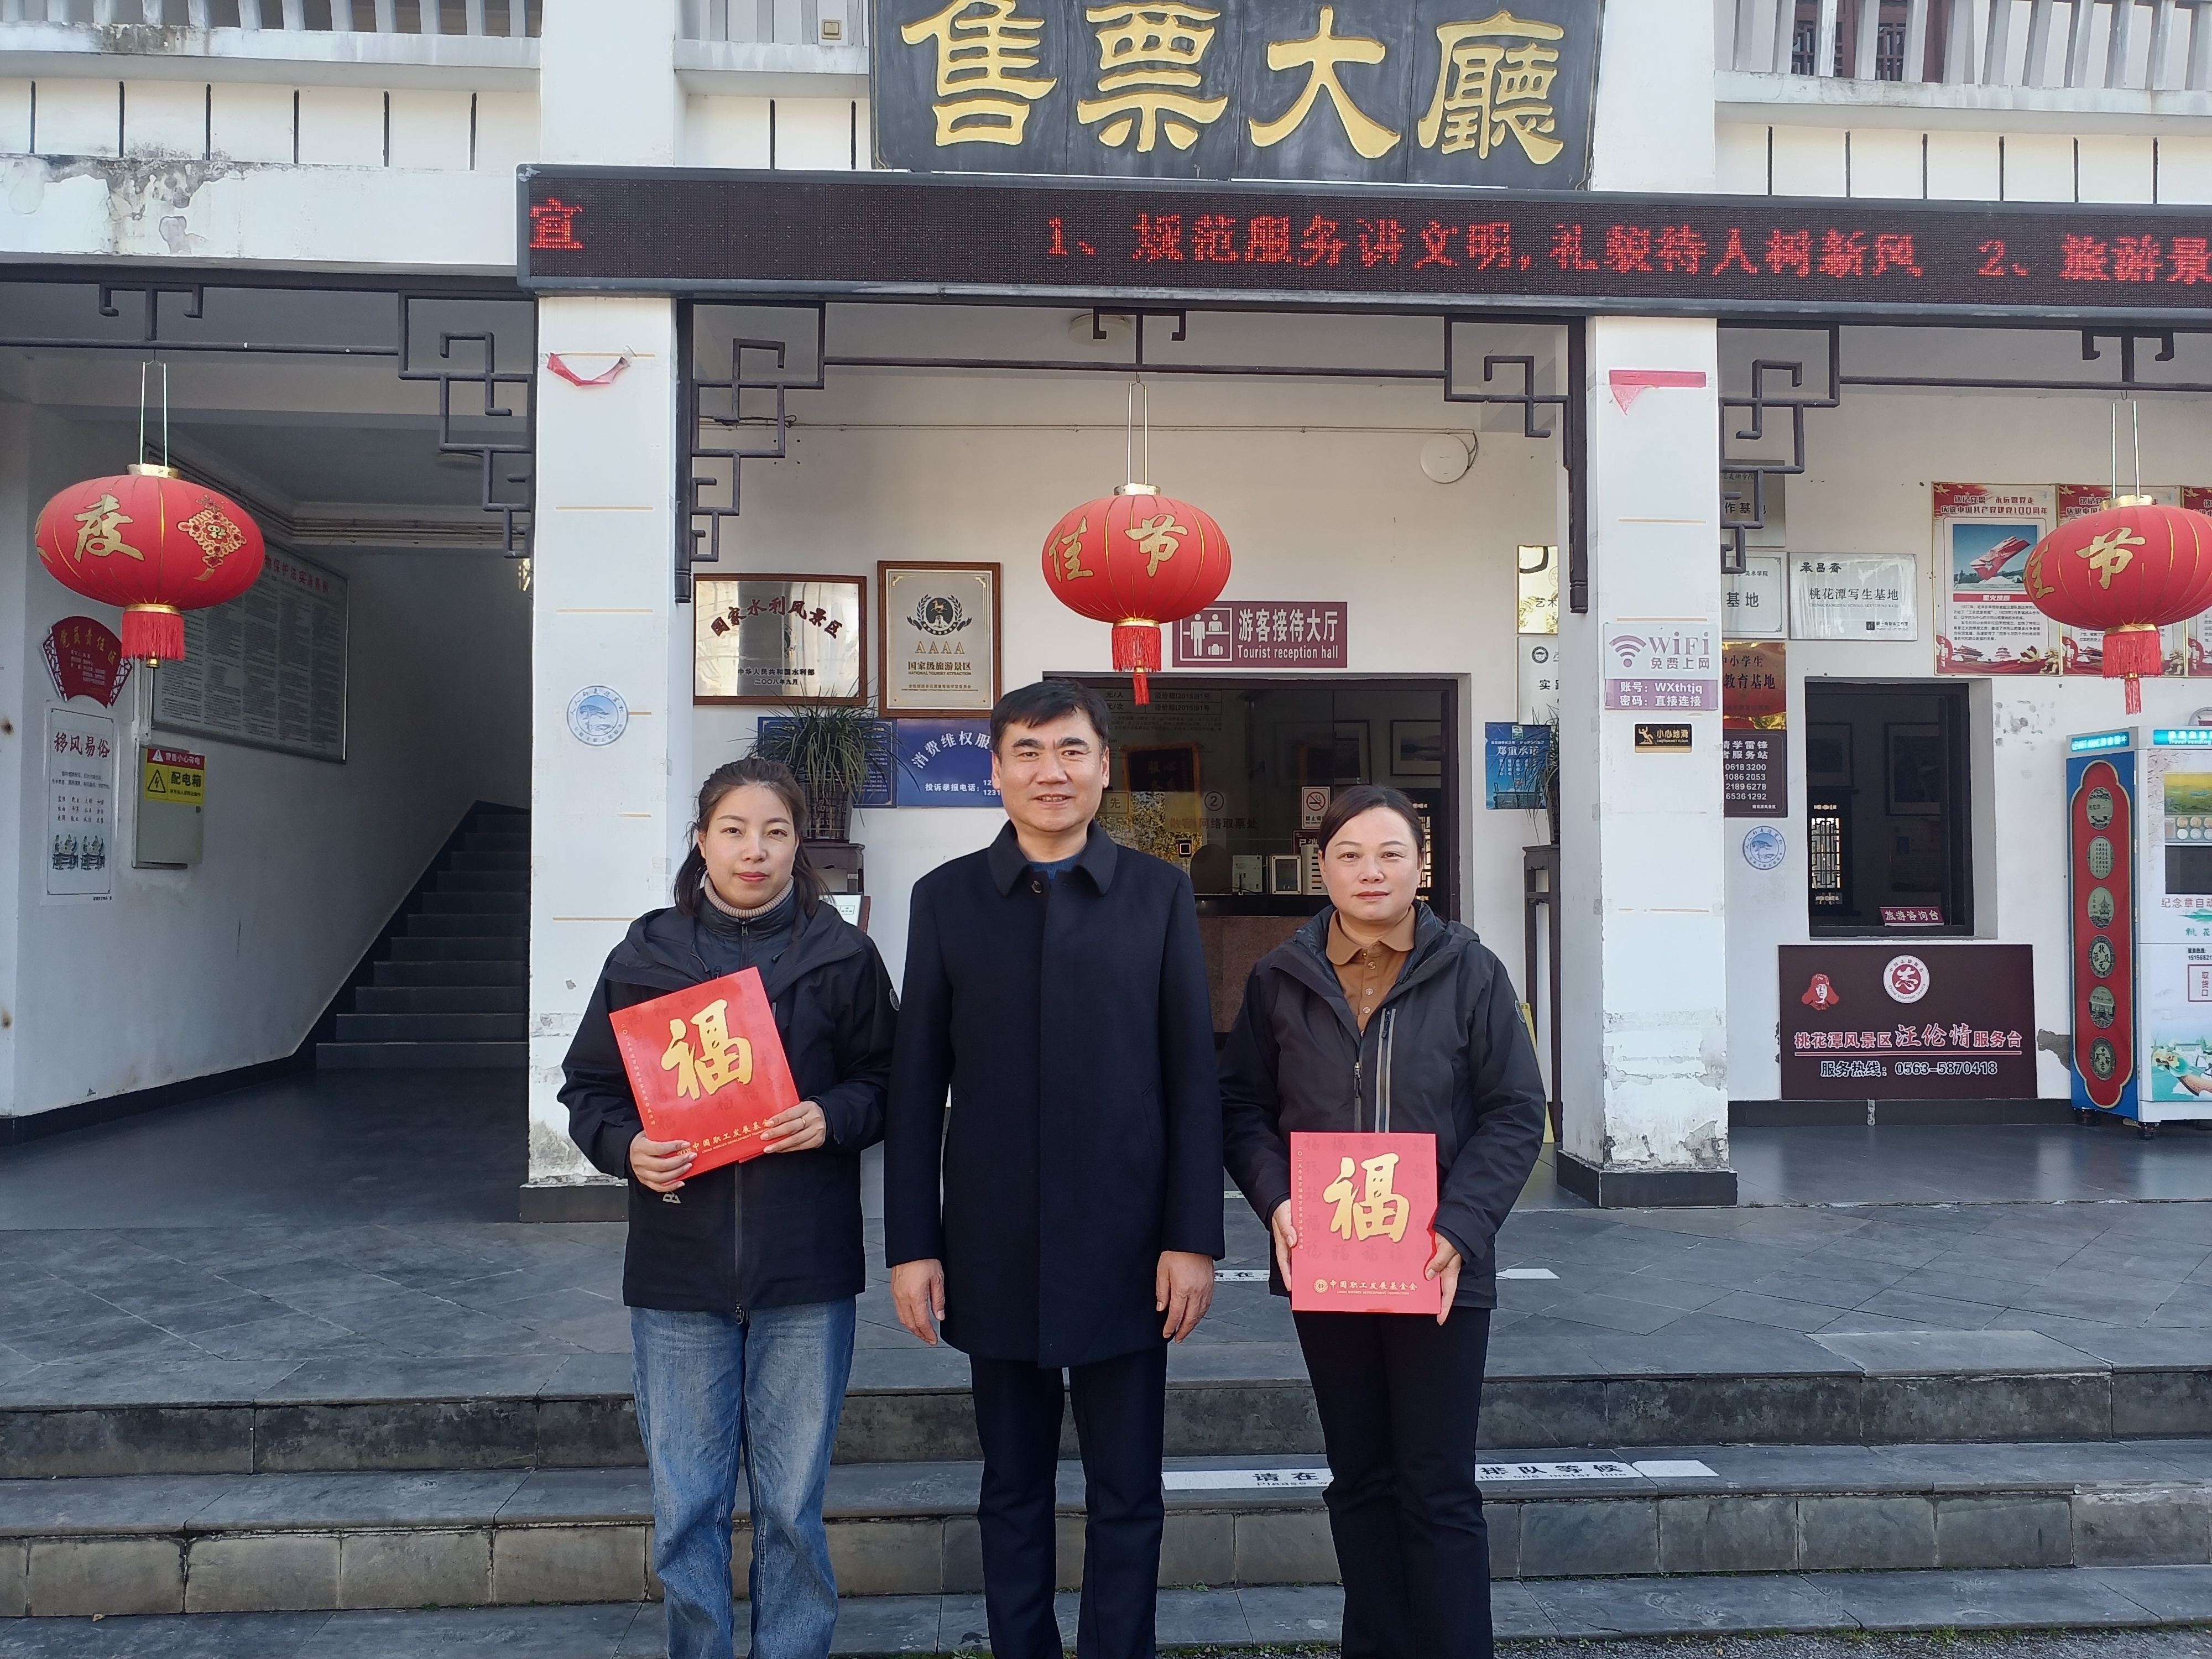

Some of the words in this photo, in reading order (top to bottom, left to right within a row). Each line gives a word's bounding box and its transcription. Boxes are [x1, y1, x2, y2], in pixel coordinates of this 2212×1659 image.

[1724, 502, 1766, 514] 作基
[1726, 592, 1759, 608] 基地
[1808, 587, 1899, 601] 桃花潭写生基地
[711, 596, 842, 639] 国家水利风景区
[1237, 608, 1339, 644] 游客接待大厅
[1648, 632, 1710, 655] WiFi
[1237, 645, 1270, 659] Tourist
[1274, 645, 1318, 661] reception
[1321, 645, 1339, 659] hall
[908, 661, 972, 671] 国家级旅游景区
[1651, 657, 1710, 669] 免费上网
[738, 667, 815, 676] 中华人民共和国水利部
[1724, 673, 1776, 689] 教育基地
[1657, 729, 1688, 739] 小心地滑
[54, 732, 110, 759] 移风易俗
[910, 731, 993, 769] 消费维权服
[171, 771, 202, 787] 配电箱
[1885, 910, 1939, 922] 旅游咨询台
[2201, 971, 2209, 997] 取货口
[661, 998, 754, 1101] 福
[1323, 1152, 1410, 1243] 福
[1329, 1279, 1418, 1291] 中国职工发展基金会
[1252, 1472, 1333, 1481] 请在
[1480, 1464, 1623, 1475] 排队等候
